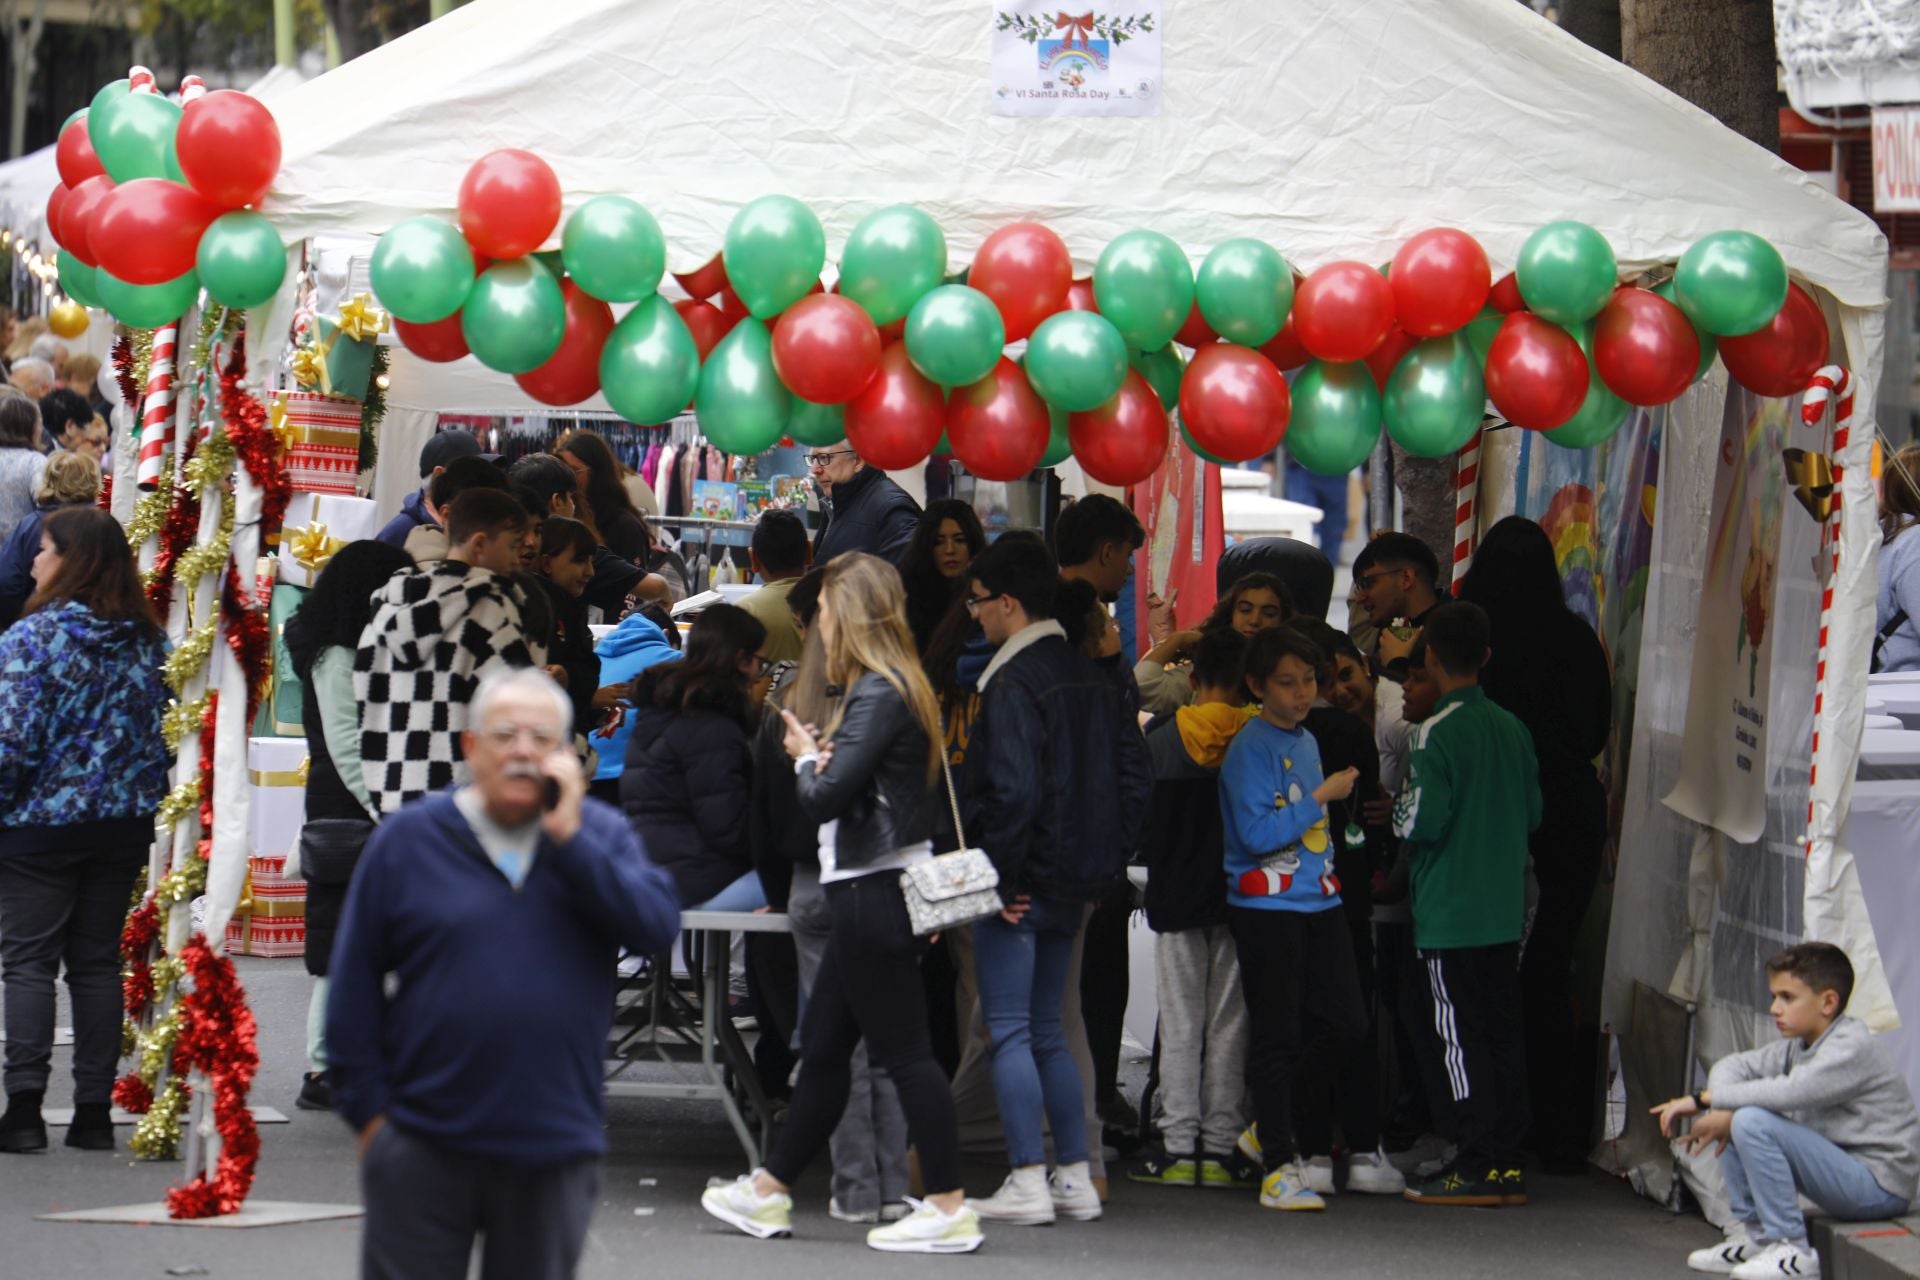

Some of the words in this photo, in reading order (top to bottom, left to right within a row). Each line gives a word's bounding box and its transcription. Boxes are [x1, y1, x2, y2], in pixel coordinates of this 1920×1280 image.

[1029, 89, 1059, 98] Santa
[1062, 89, 1087, 98] Rosa
[1090, 89, 1110, 100] Day
